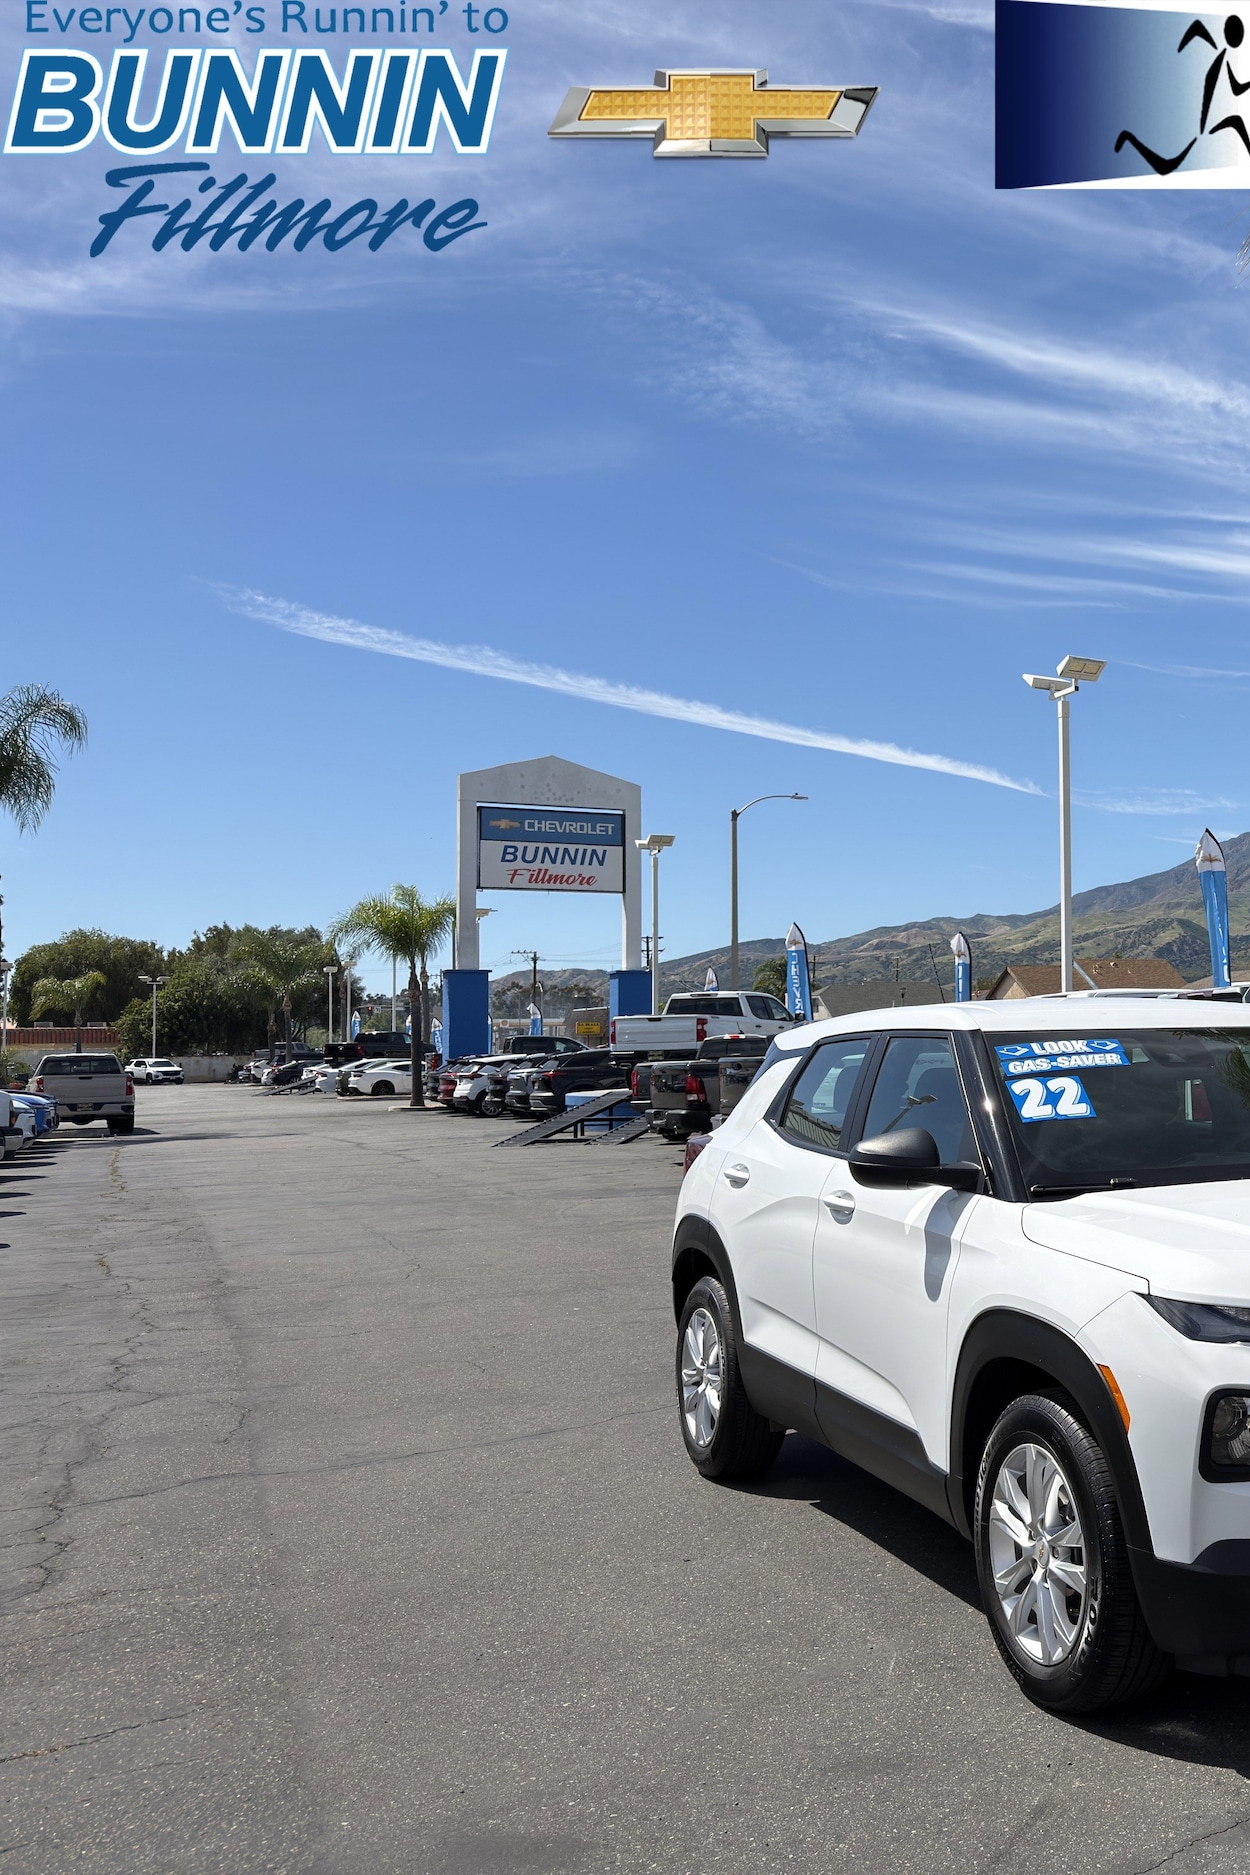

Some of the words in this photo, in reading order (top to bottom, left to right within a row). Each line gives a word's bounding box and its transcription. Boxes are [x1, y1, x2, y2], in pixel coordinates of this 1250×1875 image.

[524, 819, 616, 836] CHEVROLET
[500, 844, 608, 867] BUNNIN
[505, 868, 598, 887] Fillmore
[1030, 1040, 1093, 1055] LOOK
[1008, 1053, 1122, 1074] GAS-SAVER
[1011, 1077, 1091, 1119] 22
